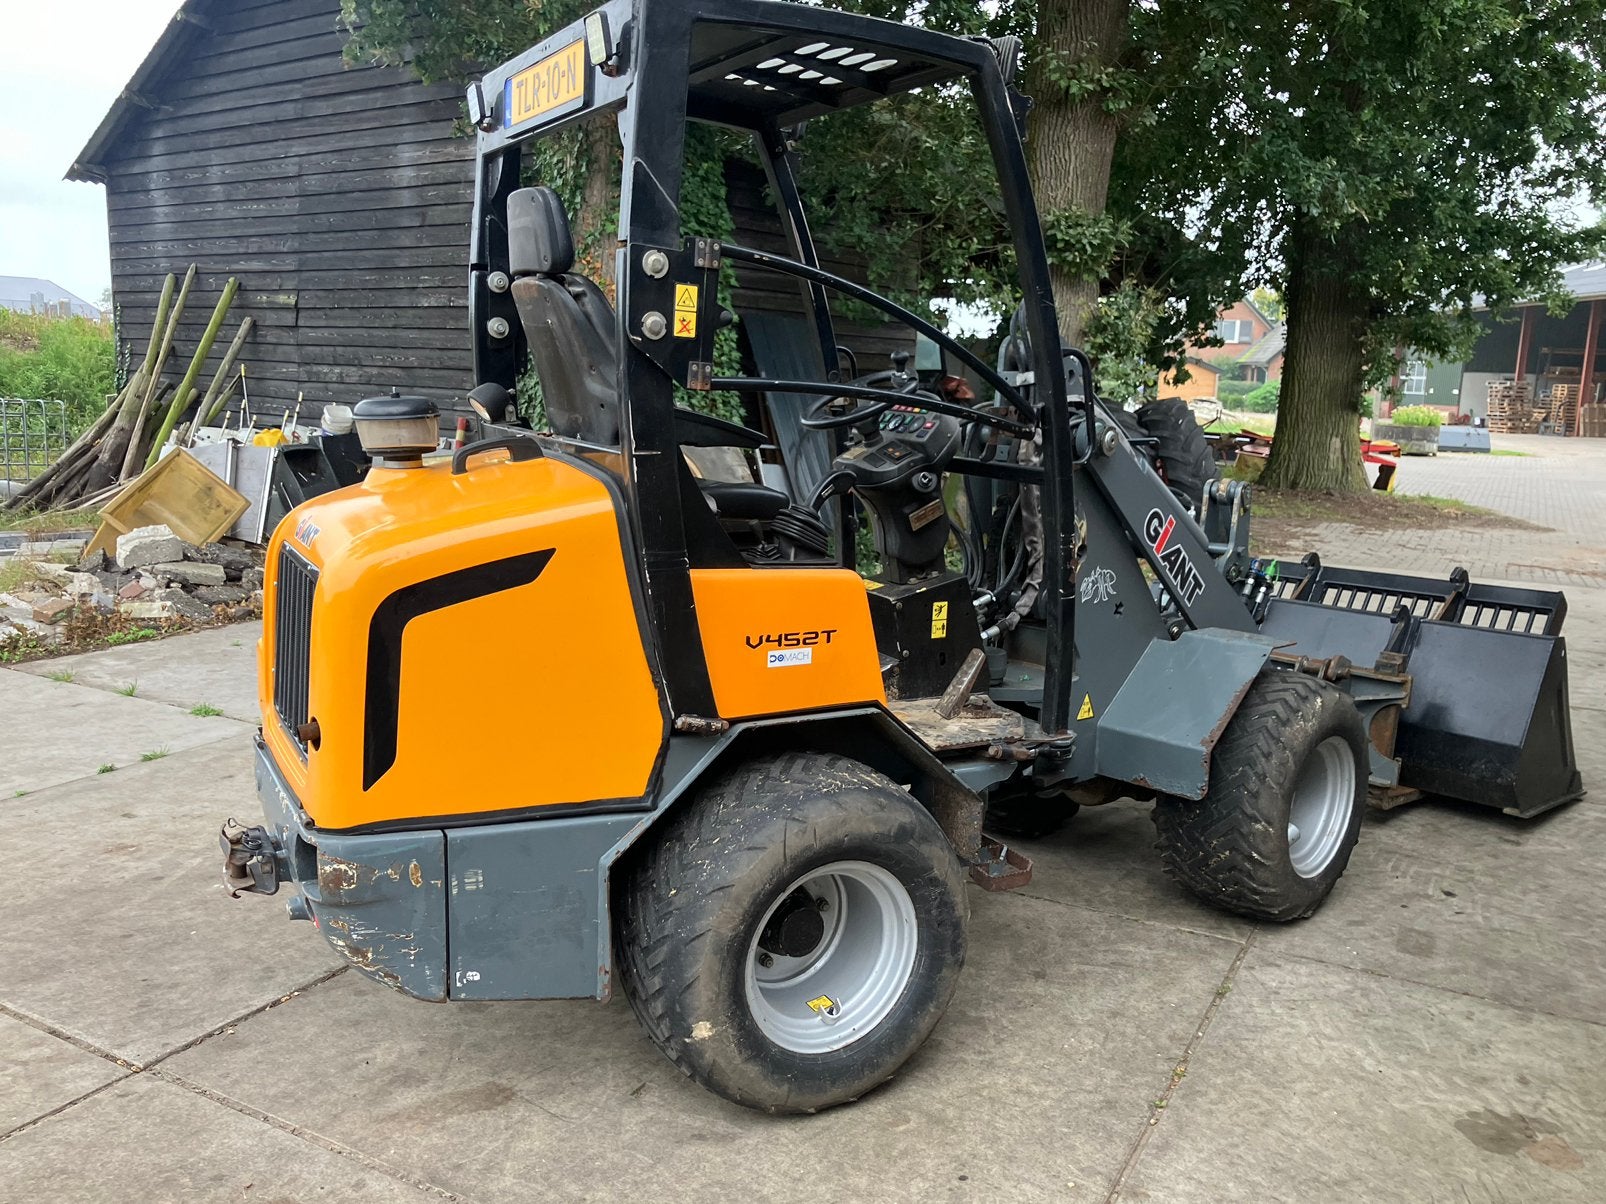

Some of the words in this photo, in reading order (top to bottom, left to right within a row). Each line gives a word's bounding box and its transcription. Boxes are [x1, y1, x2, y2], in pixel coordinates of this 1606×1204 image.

[516, 52, 576, 116] TLR-10-N
[1144, 508, 1206, 608] GIANT
[745, 629, 838, 650] V452T
[769, 651, 810, 663] DOMACH
